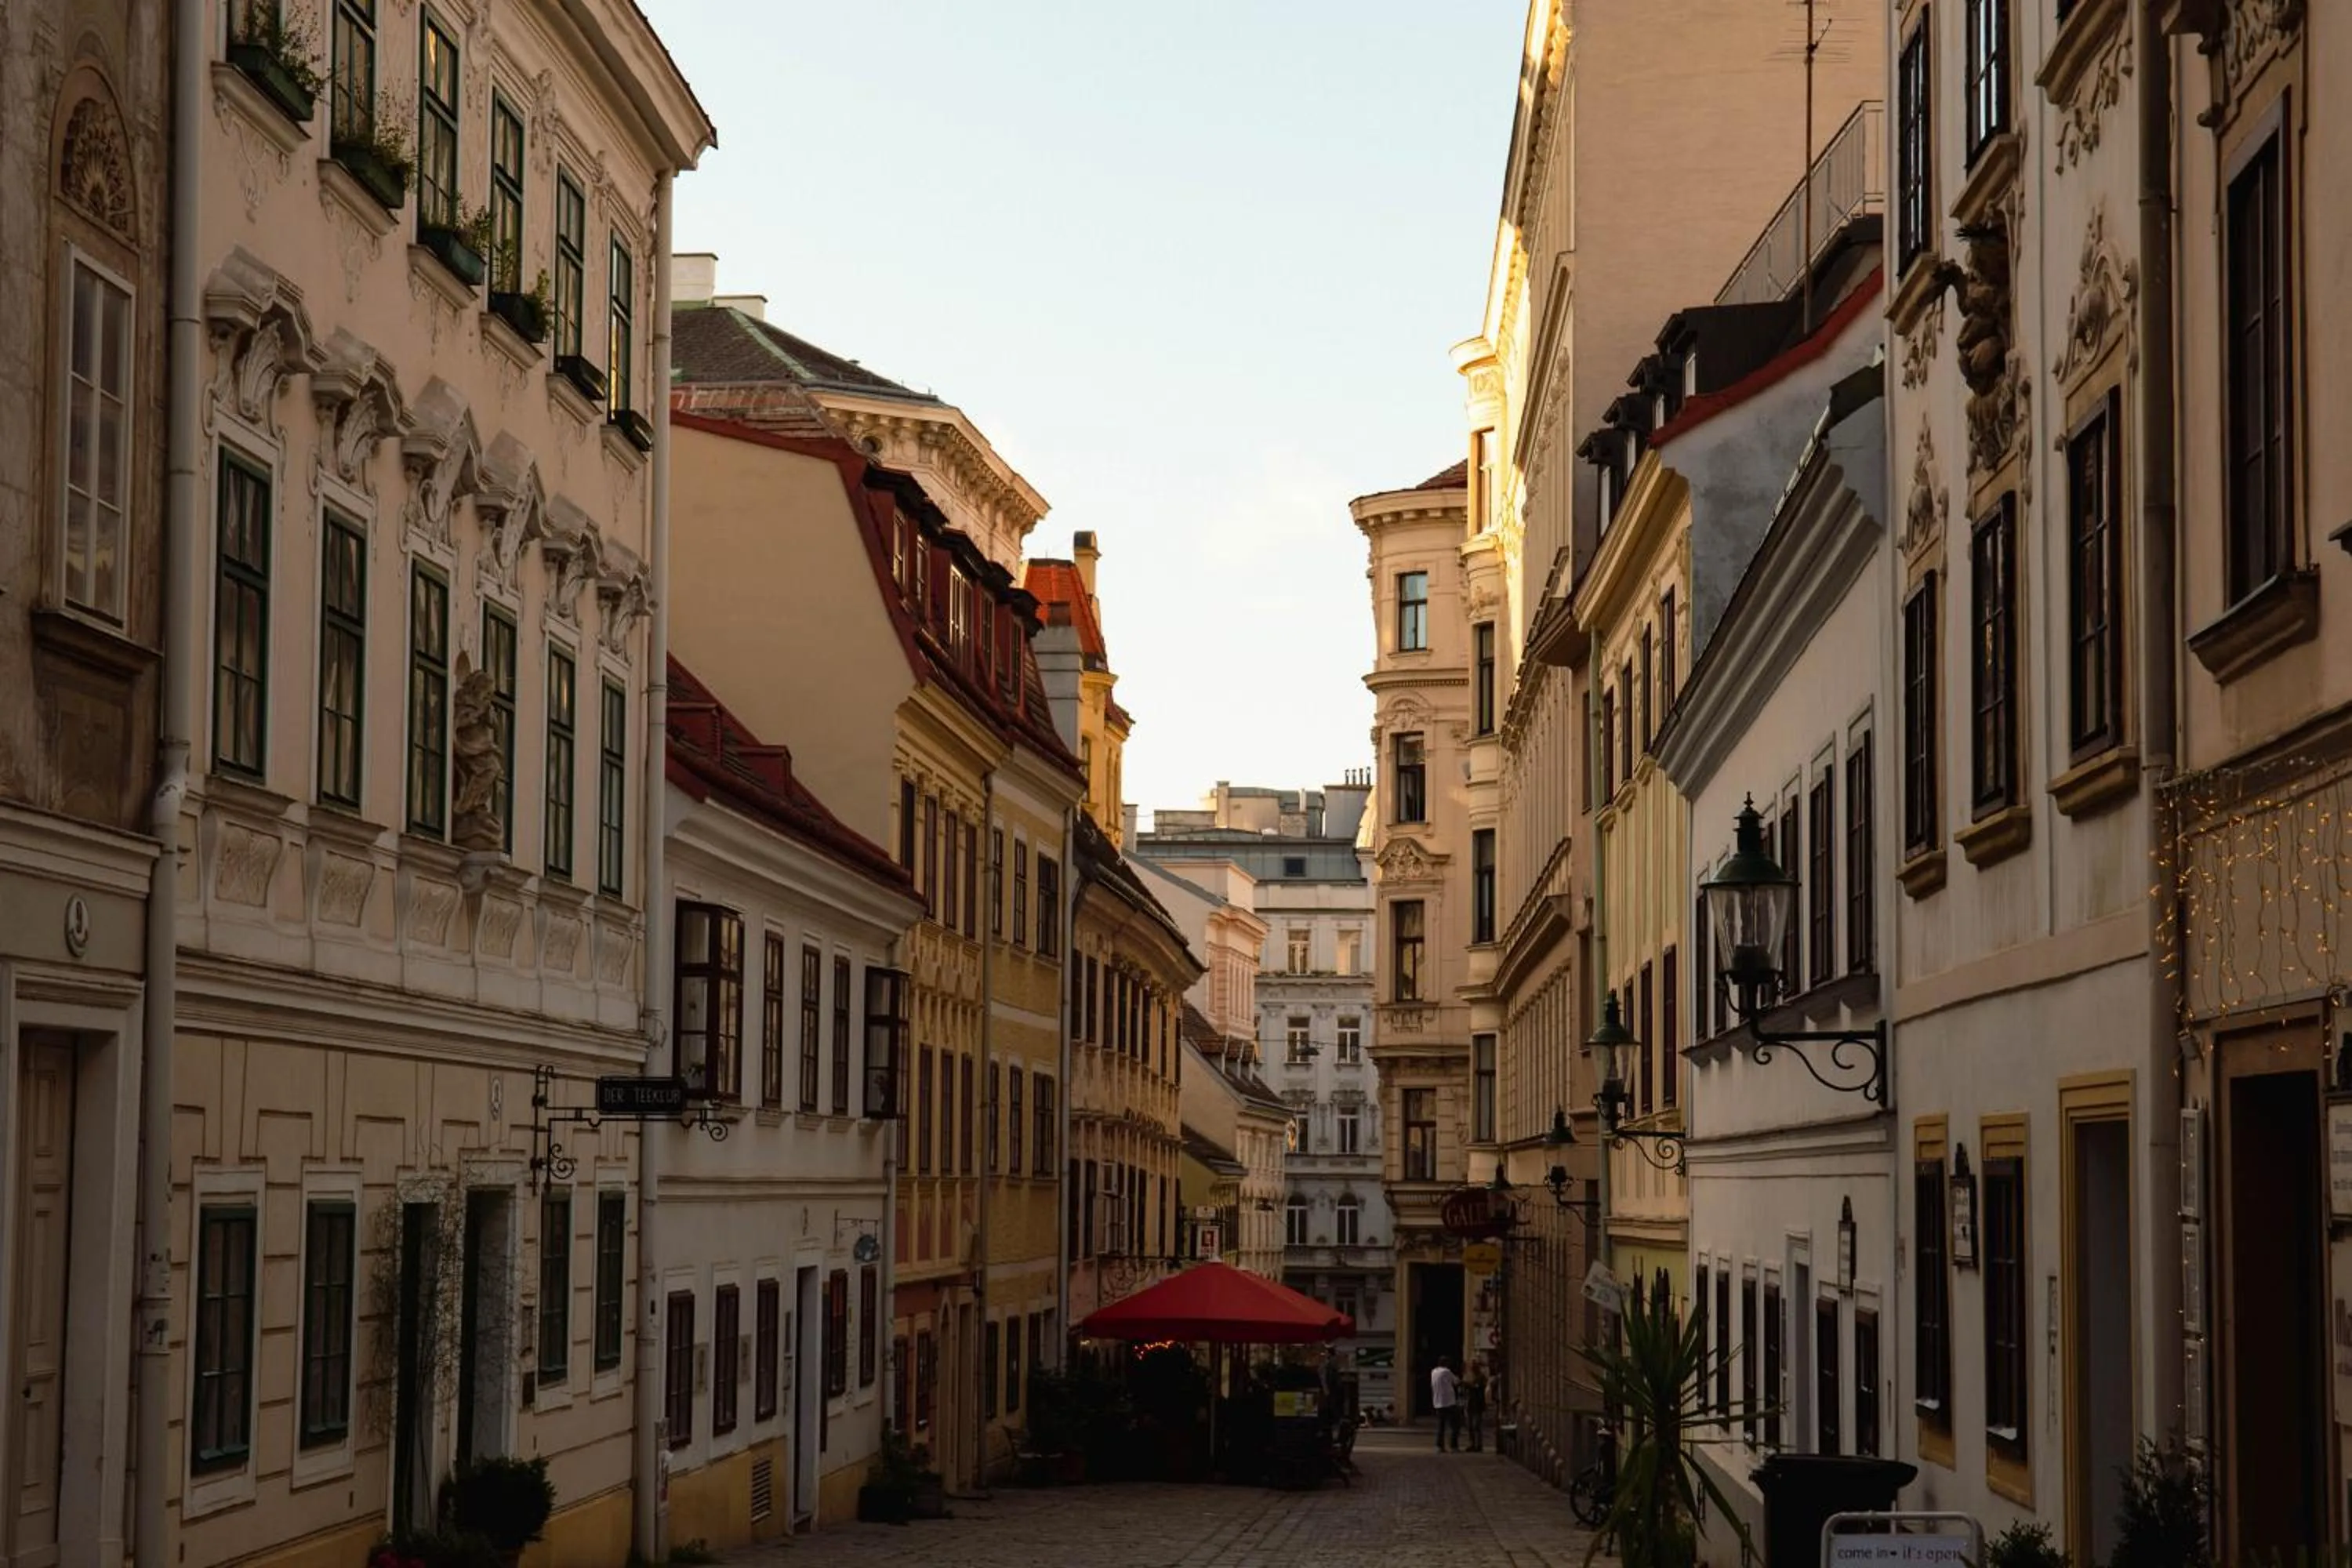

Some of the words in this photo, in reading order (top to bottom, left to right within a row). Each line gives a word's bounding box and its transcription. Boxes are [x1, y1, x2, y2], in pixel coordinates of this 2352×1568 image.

[604, 1087, 624, 1103] DER
[1838, 1548, 1872, 1559] come
[1926, 1548, 1960, 1563] open
